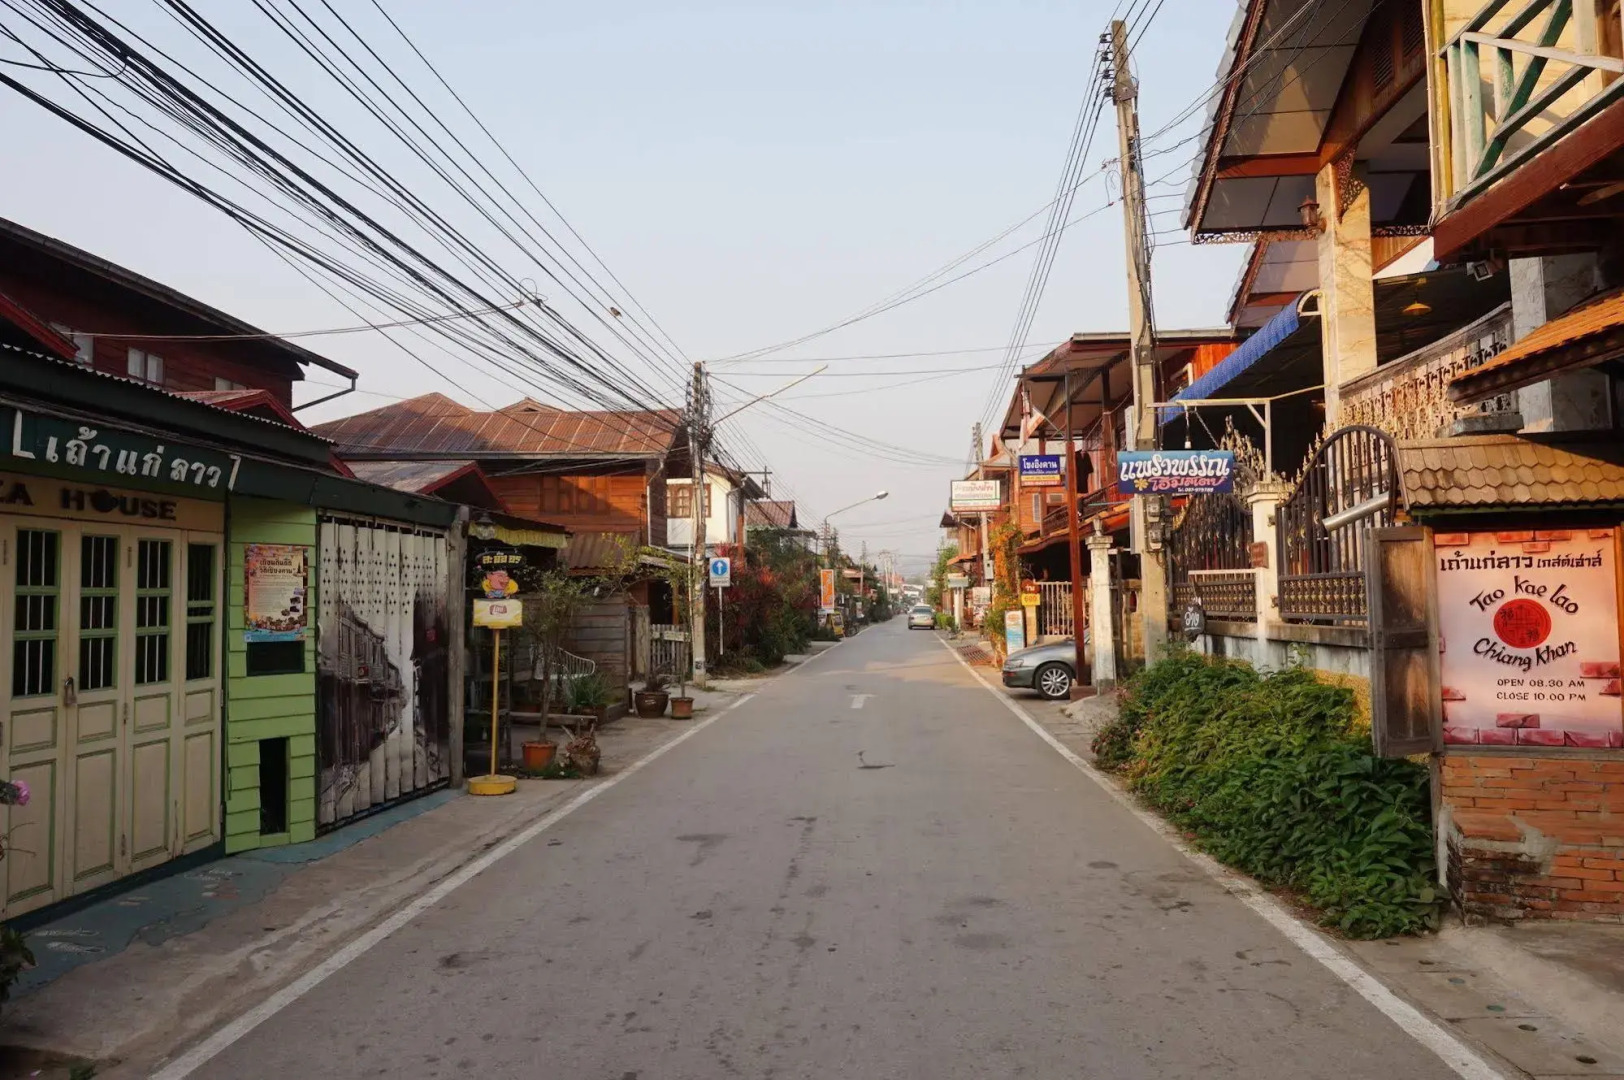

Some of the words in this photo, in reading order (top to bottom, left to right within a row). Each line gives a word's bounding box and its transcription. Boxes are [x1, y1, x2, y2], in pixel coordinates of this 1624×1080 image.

[1440, 550, 1533, 572] เถ้าแก่ลาว
[1469, 589, 1505, 612] Tao
[1473, 637, 1532, 672] Chiang
[1535, 641, 1578, 666] Khan
[1497, 679, 1524, 687] OPEN
[1529, 679, 1563, 687] 08.30
[1496, 692, 1529, 700] CLOSE
[1534, 693, 1565, 701] 10.00
[1569, 693, 1586, 701] PM
